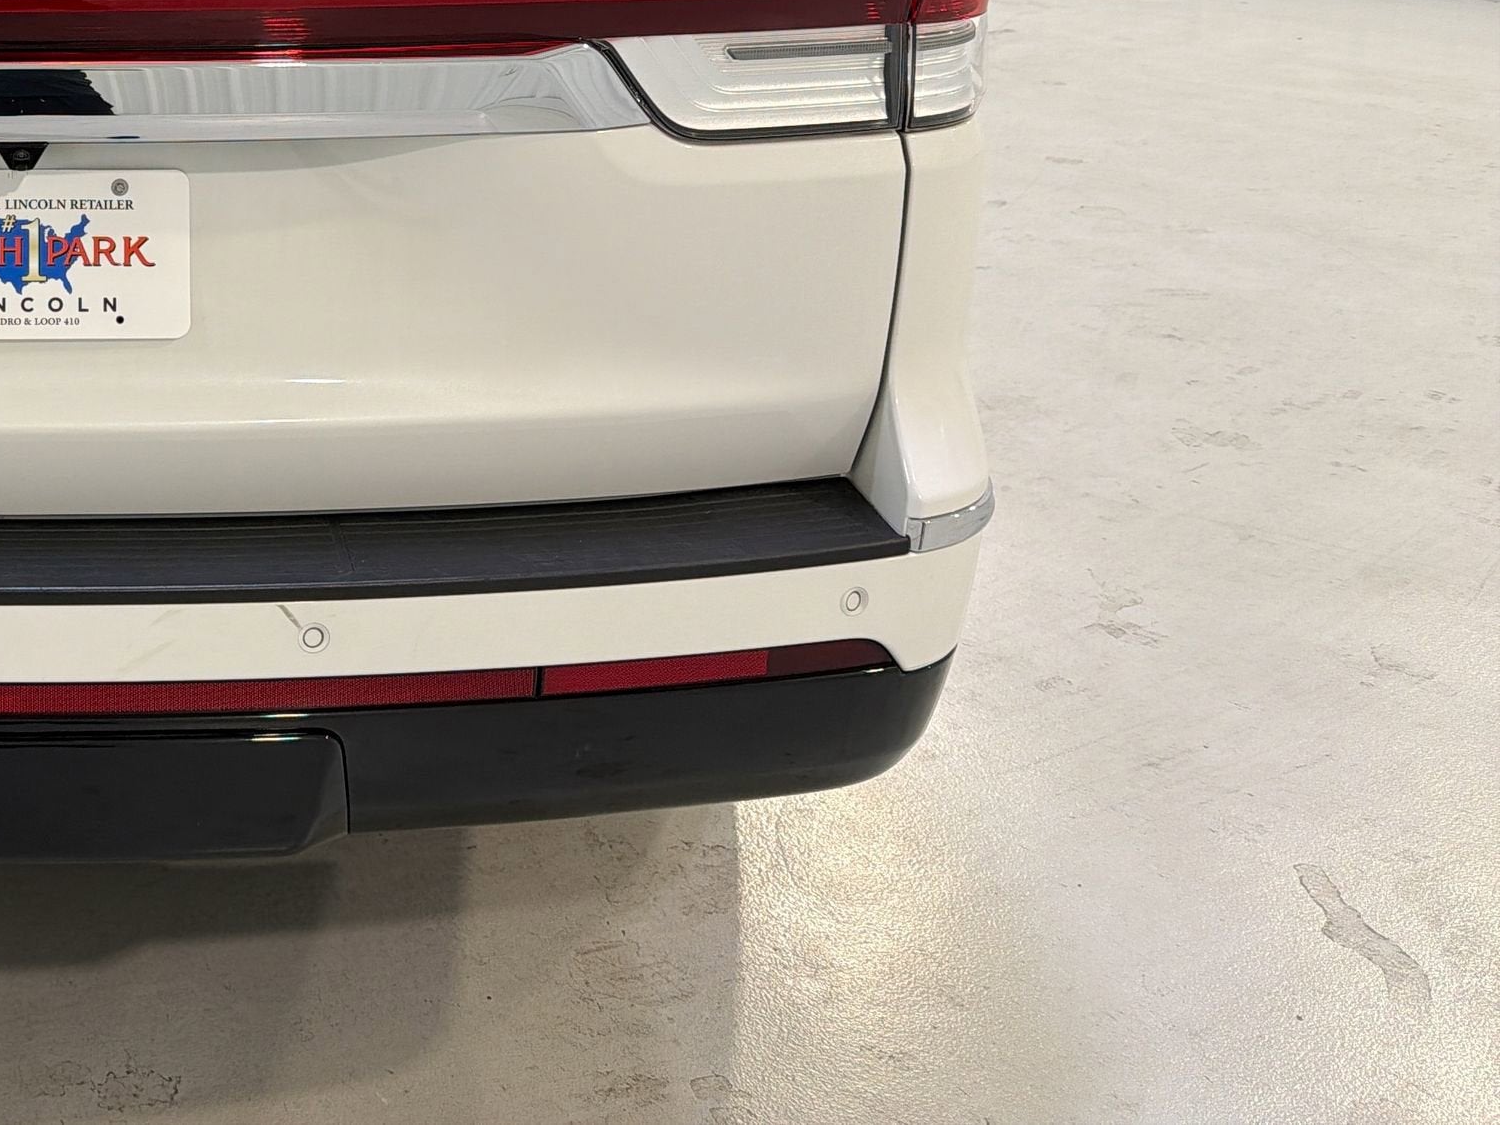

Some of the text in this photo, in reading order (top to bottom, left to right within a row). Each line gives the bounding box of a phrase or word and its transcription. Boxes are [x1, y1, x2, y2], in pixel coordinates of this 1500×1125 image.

[5, 199, 66, 210] LINCOLN
[70, 199, 134, 211] RETAILER
[46, 236, 156, 267] PARK
[24, 317, 31, 326] &
[34, 317, 61, 326] LOOP
[64, 317, 80, 326] 410
